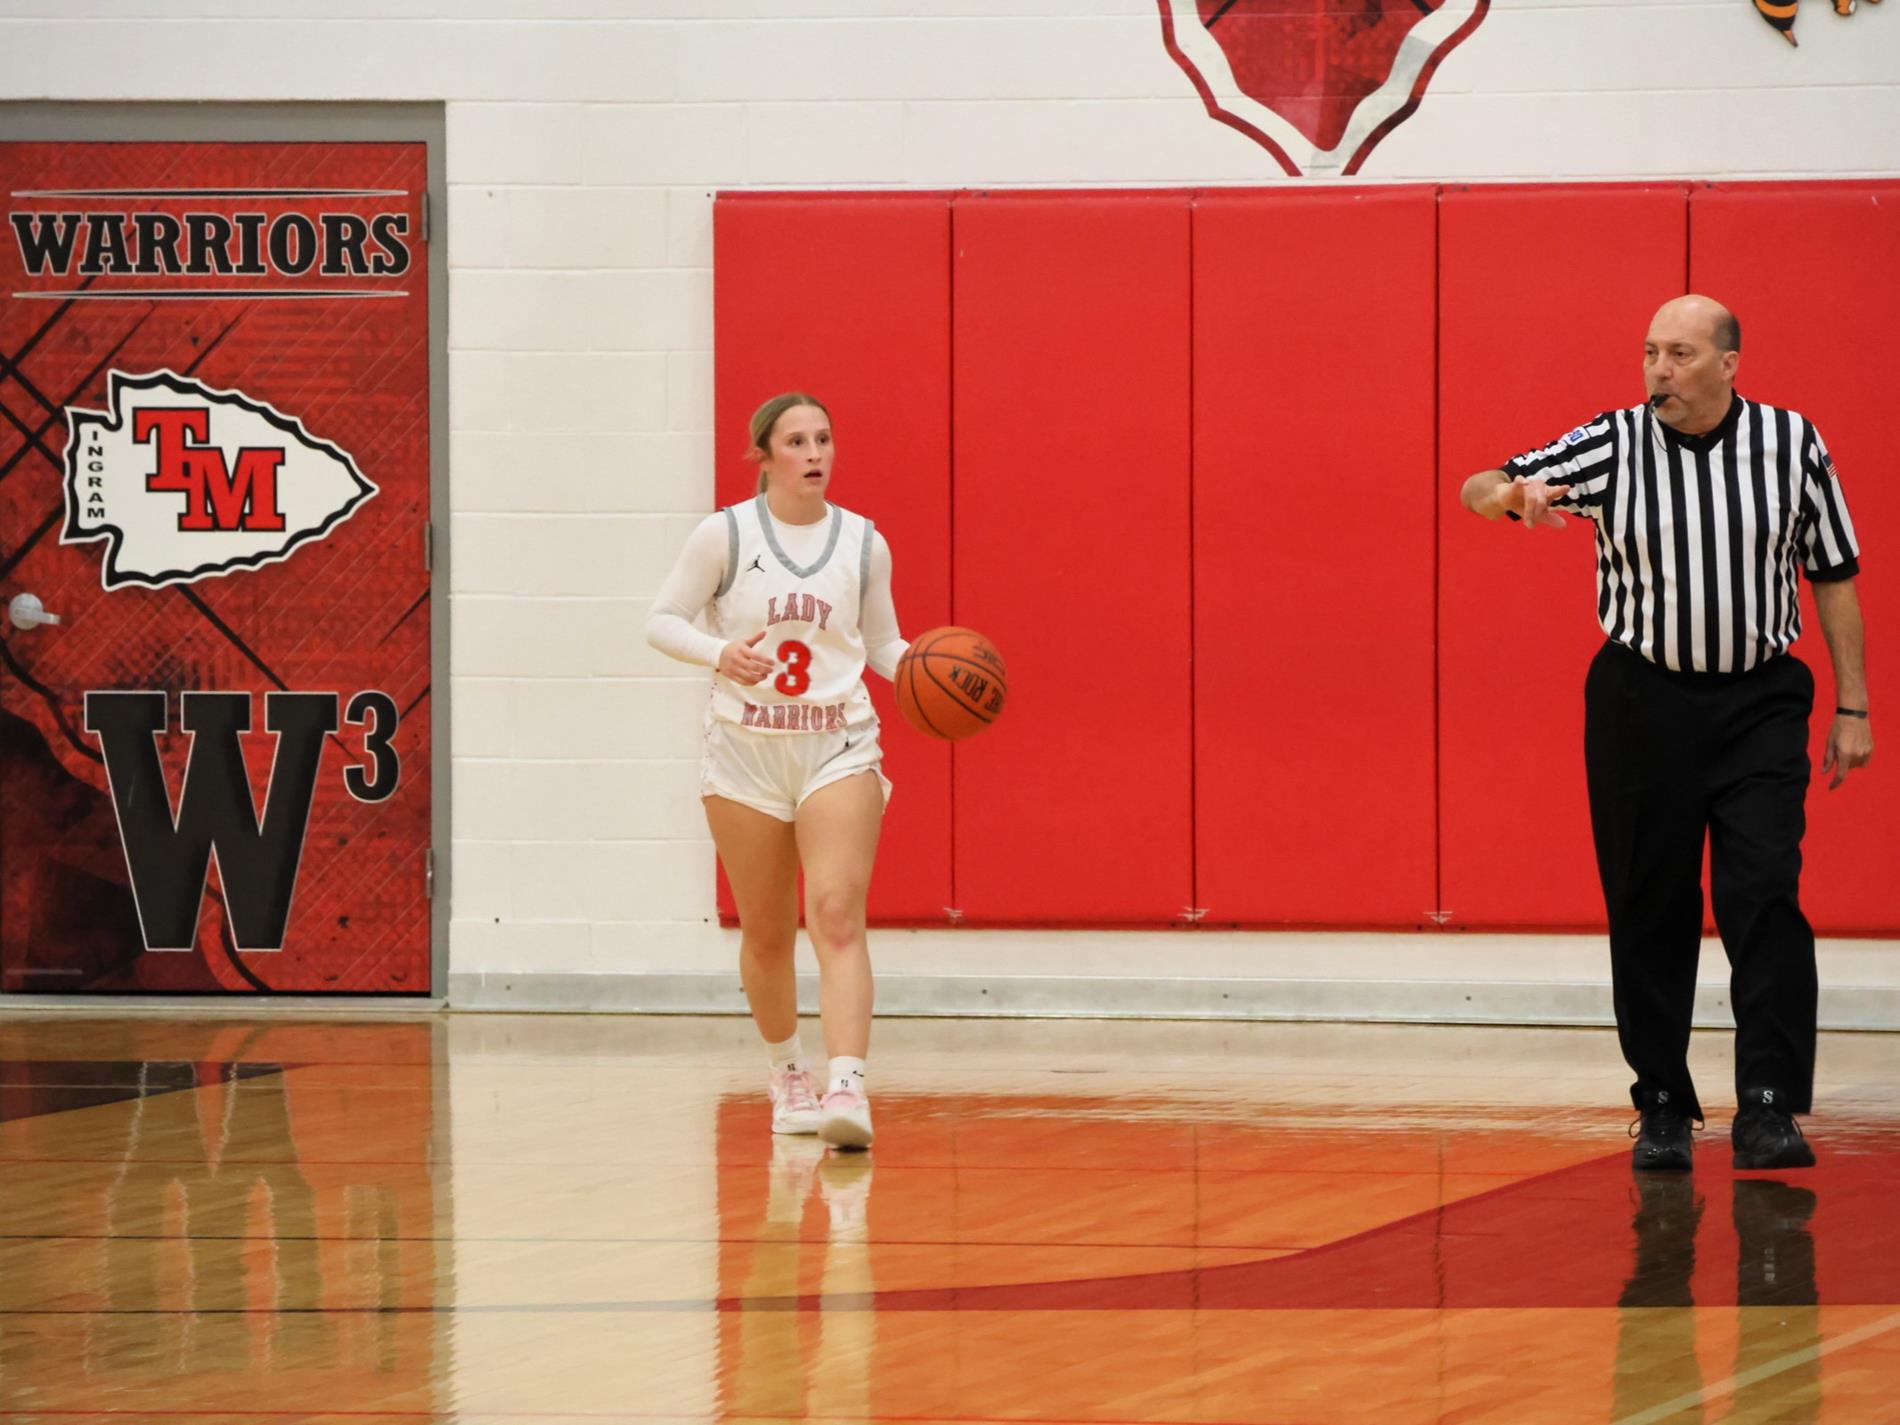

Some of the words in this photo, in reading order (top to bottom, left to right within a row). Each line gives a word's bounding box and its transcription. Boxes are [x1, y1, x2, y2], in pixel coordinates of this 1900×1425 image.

[9, 212, 411, 277] WARRIORS
[87, 430, 105, 519] INGRAM
[132, 407, 286, 532] TM
[766, 592, 832, 631] LADY
[774, 639, 813, 697] 3
[740, 701, 848, 732] WARRIORS
